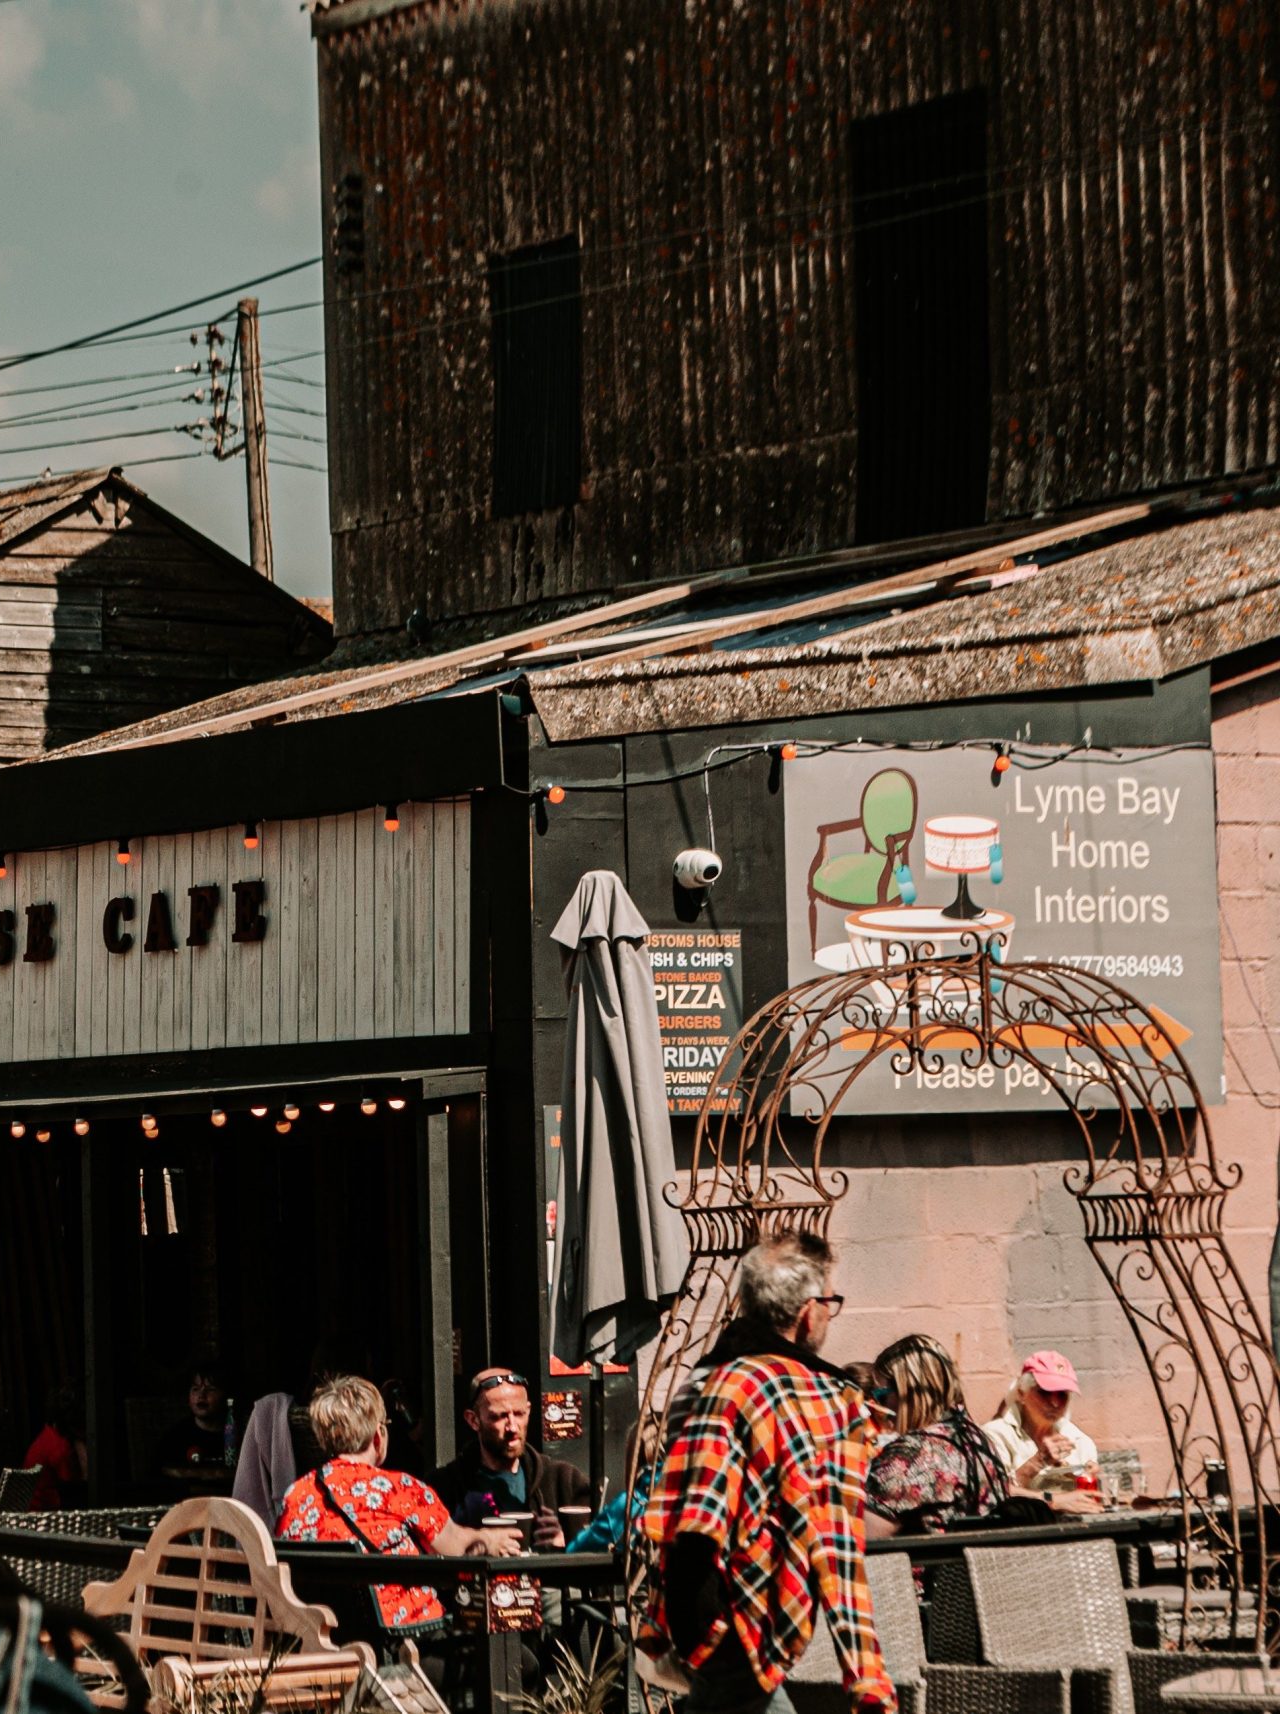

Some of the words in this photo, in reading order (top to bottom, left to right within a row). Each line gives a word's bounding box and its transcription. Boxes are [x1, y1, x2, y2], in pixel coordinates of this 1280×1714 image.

[1015, 775, 1106, 823] Lyme
[1118, 777, 1181, 824] Bay
[1051, 830, 1150, 869] Home
[1035, 886, 1169, 923] Interiors
[103, 880, 267, 953] CAFE
[644, 934, 694, 947] USTOMS
[697, 934, 741, 947] HOUSE
[649, 952, 673, 967] ISH
[676, 952, 687, 967] &
[690, 952, 734, 967] CHIPS
[1023, 955, 1053, 978] Tl
[655, 972, 686, 982] STONE
[688, 972, 722, 982] BAKED
[654, 984, 726, 1009] PIZZA
[658, 1015, 721, 1029] BURGERS
[660, 1037, 670, 1045] EN
[677, 1037, 699, 1045] DAYS
[706, 1036, 730, 1045] WEEK
[663, 1046, 727, 1067] RIDAY
[894, 1057, 995, 1089] Please
[1004, 1061, 1057, 1095] pay
[673, 1086, 708, 1095] ORDERS
